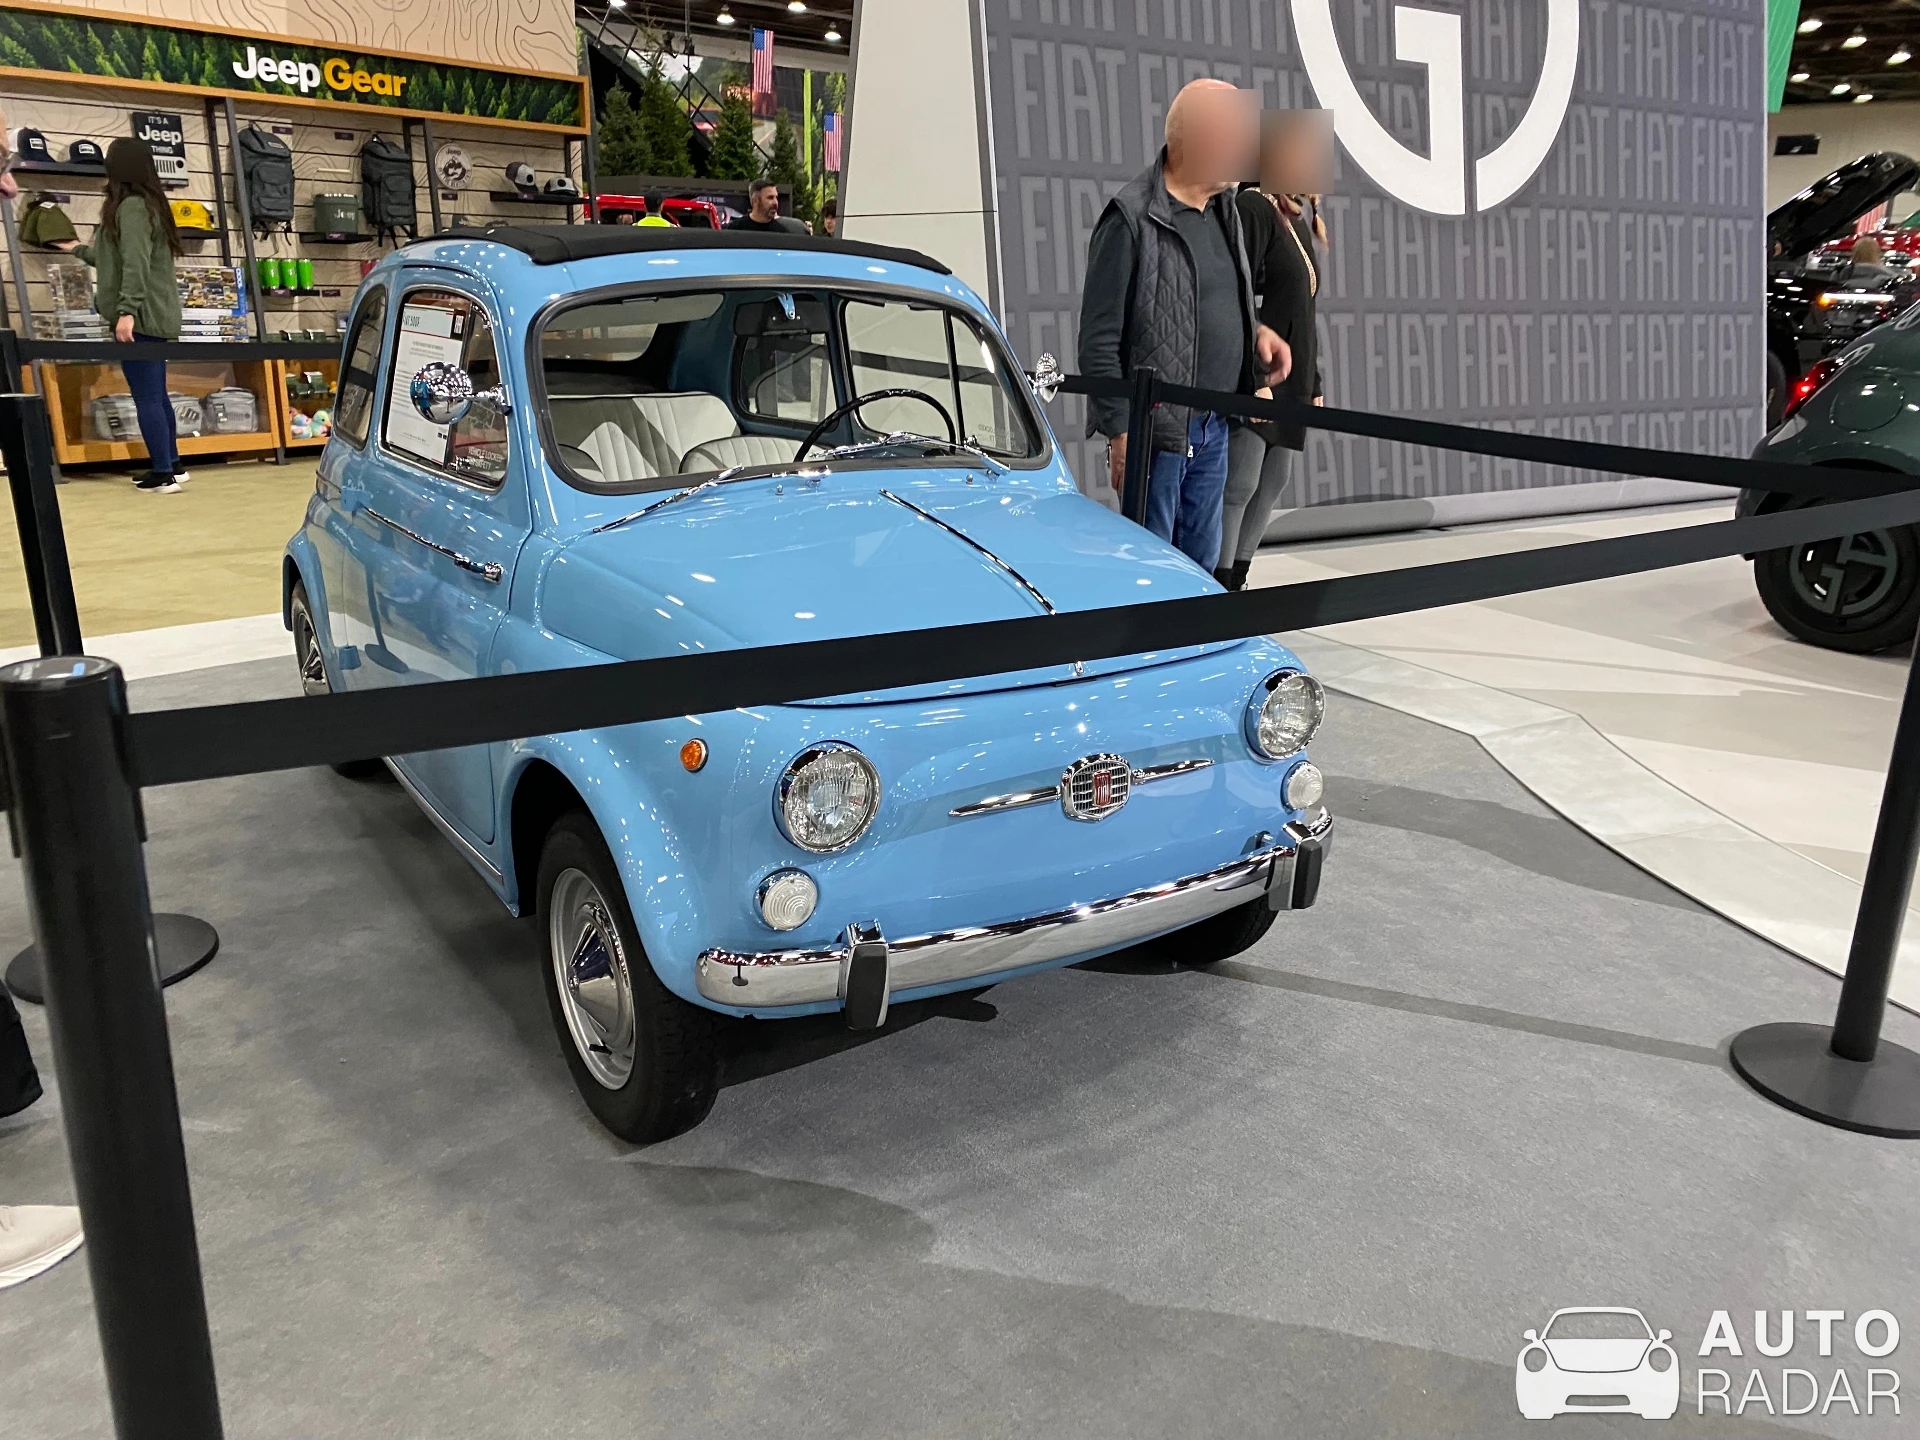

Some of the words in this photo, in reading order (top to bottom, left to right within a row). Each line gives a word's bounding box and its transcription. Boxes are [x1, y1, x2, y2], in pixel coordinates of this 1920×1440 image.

[232, 47, 321, 93] Jeep
[324, 57, 407, 97] Gear
[1617, 3, 1684, 100] FIAT
[1691, 15, 1754, 110] FIAT
[138, 124, 182, 146] Jeep
[147, 116, 162, 125] IT'S
[163, 117, 169, 125] A
[150, 145, 174, 155] THING
[1011, 37, 1127, 165] FIAT
[1617, 109, 1684, 202] FIAT
[1691, 117, 1754, 206] FIAT
[1020, 176, 1129, 295] FIA
[1539, 208, 1610, 301] FIAT
[1618, 212, 1685, 301] FIAT
[1692, 216, 1753, 302] FIAT
[1364, 313, 1448, 411] FIAT
[1456, 313, 1533, 409] FIAT
[1541, 313, 1612, 404] FIAT
[1619, 313, 1685, 401] FIAT
[1691, 313, 1753, 398] FIAT
